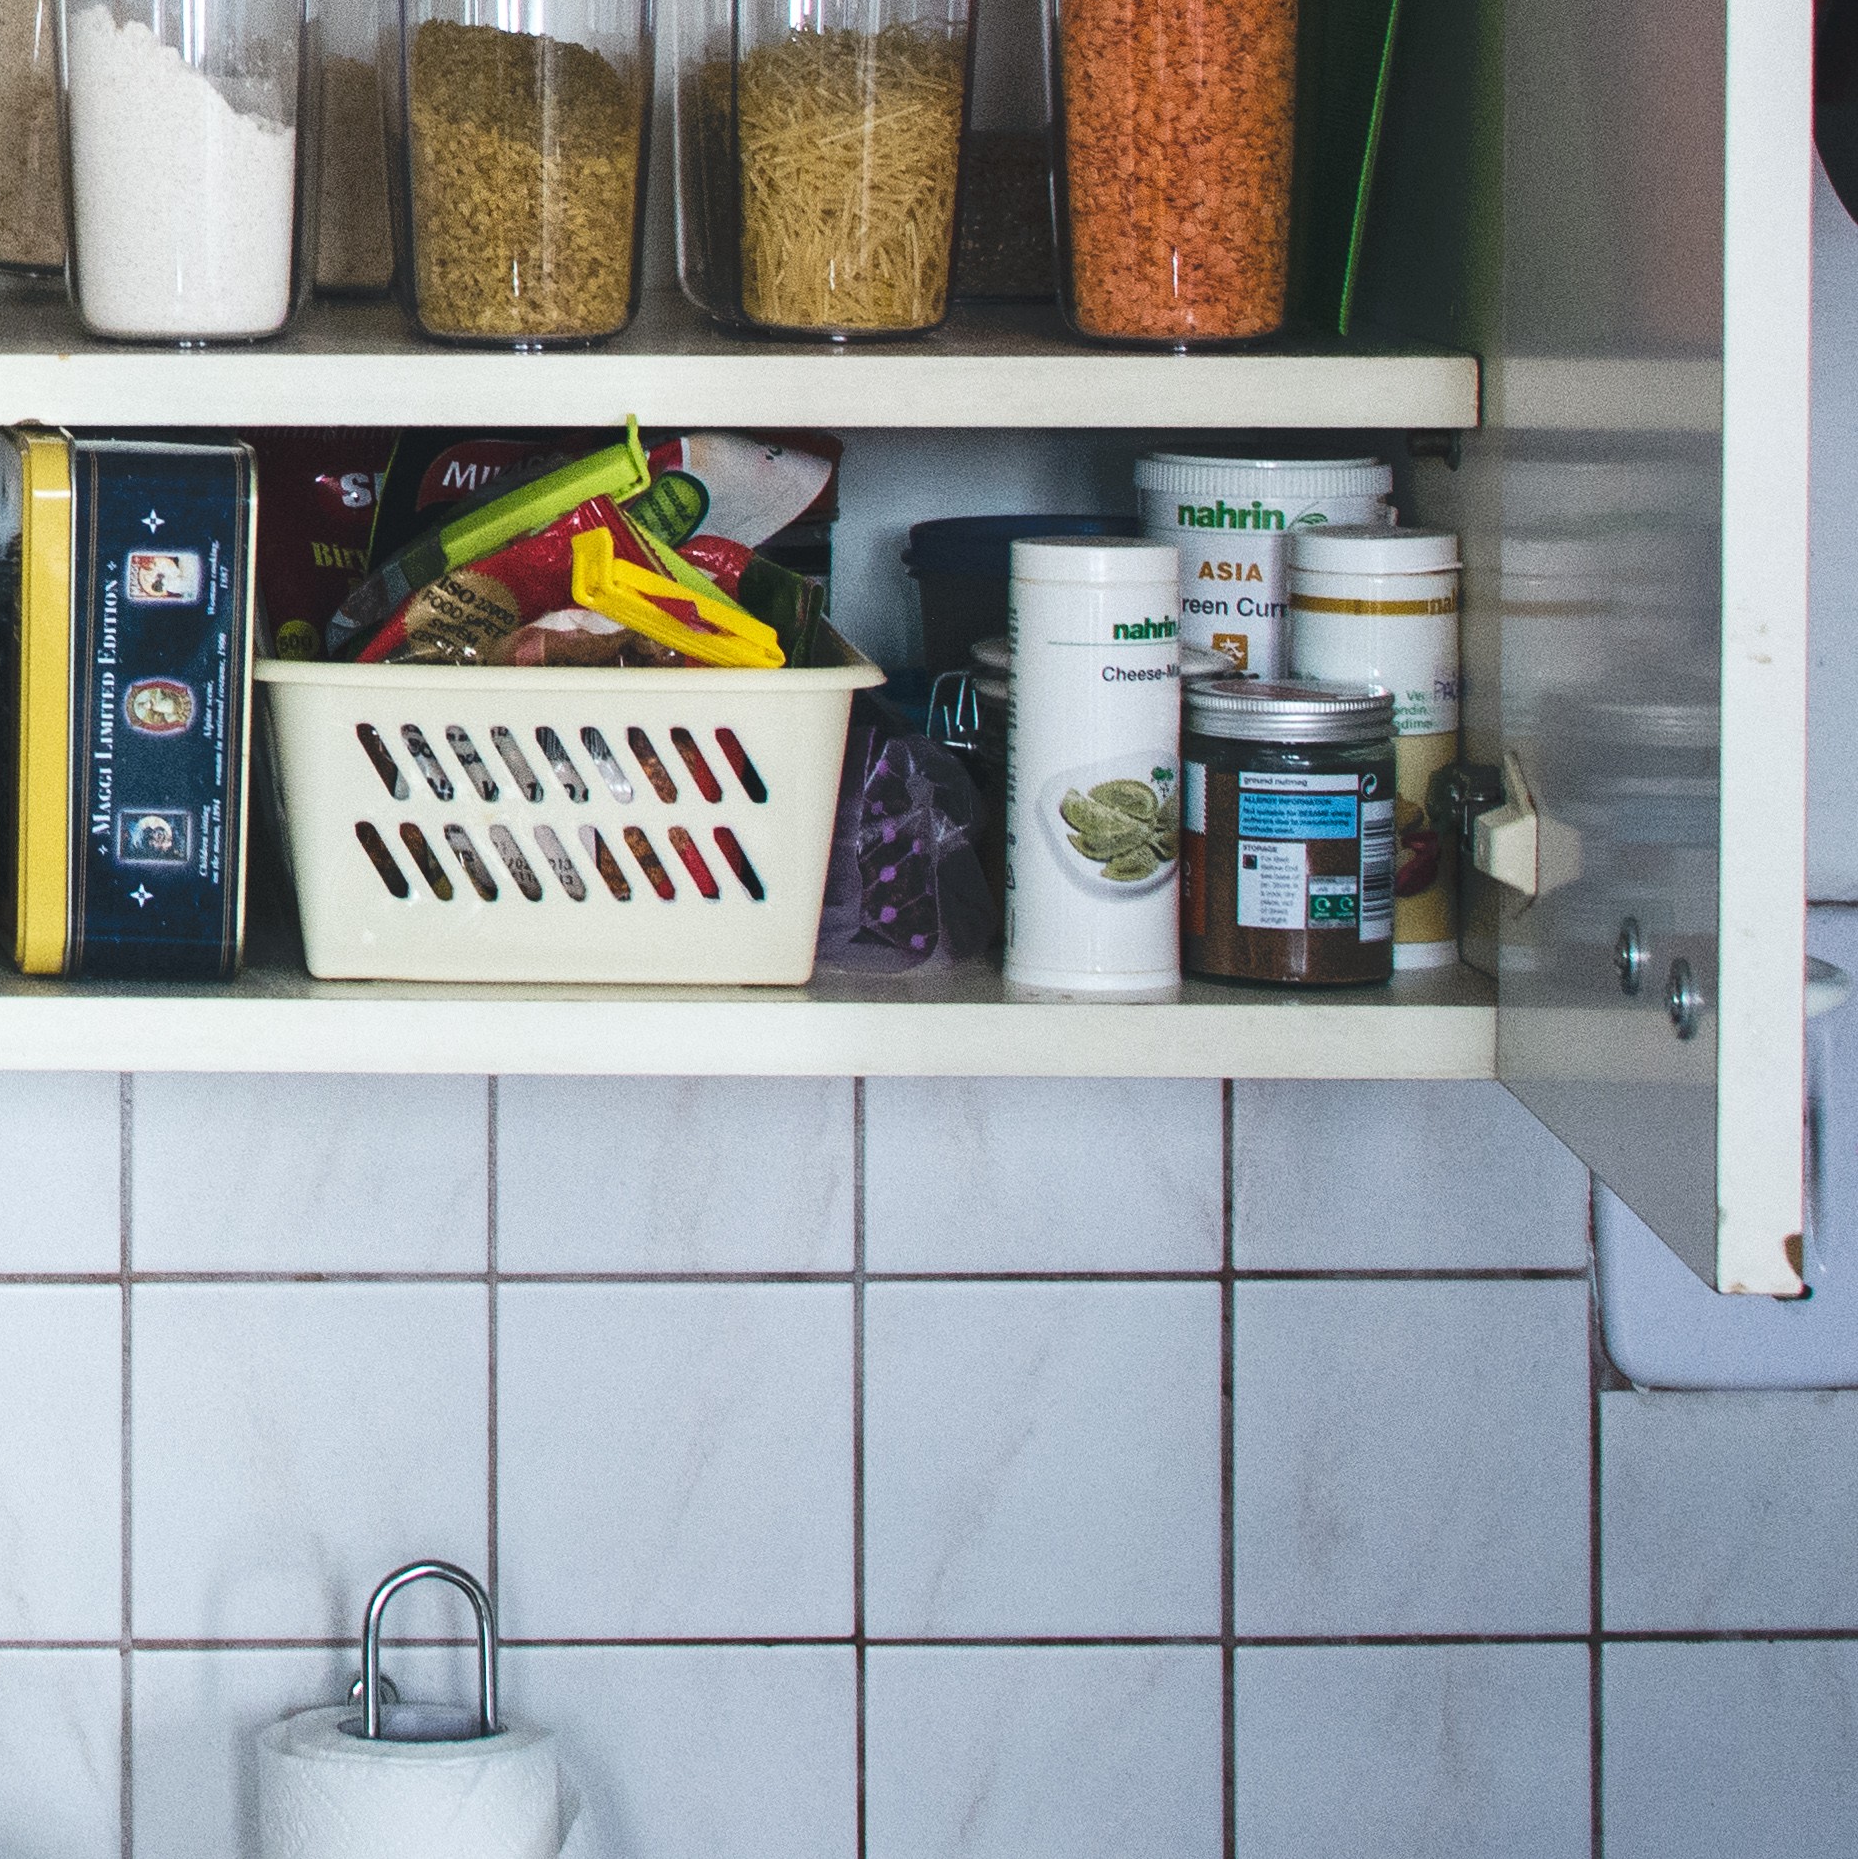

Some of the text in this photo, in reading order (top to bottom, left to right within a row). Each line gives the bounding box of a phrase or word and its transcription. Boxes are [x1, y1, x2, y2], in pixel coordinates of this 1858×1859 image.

[1177, 500, 1285, 531] nahrin
[1198, 560, 1264, 582] ASIA
[438, 574, 477, 605] ISO
[1181, 597, 1288, 619] reen Curr
[1112, 615, 1178, 641] nahrin
